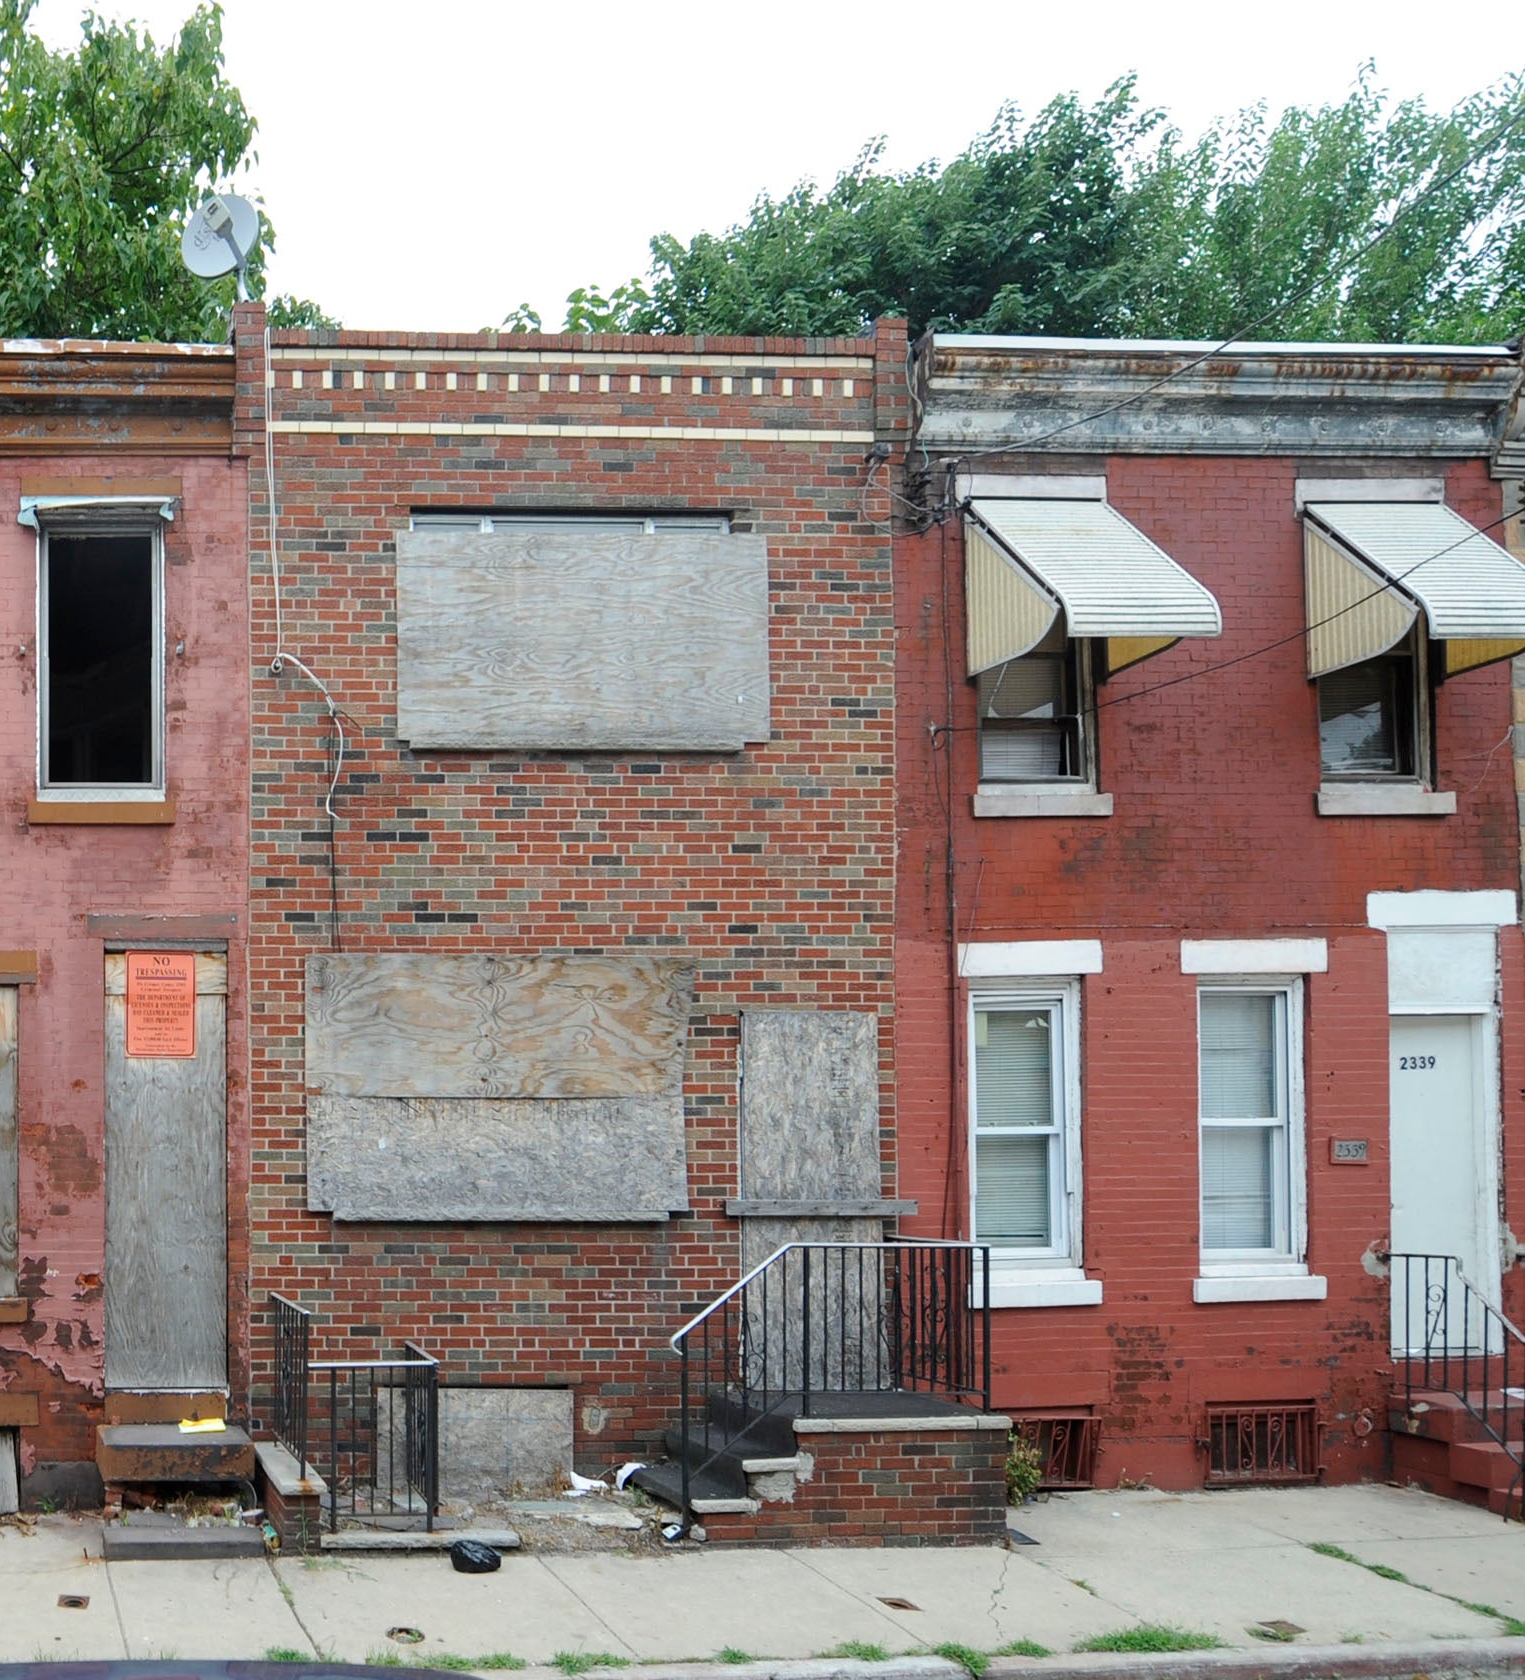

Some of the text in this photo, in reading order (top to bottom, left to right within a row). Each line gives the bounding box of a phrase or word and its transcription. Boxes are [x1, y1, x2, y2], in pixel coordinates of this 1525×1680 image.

[153, 956, 170, 966] NO
[136, 968, 187, 976] TRESPASSING
[1400, 1056, 1436, 1070] 2339
